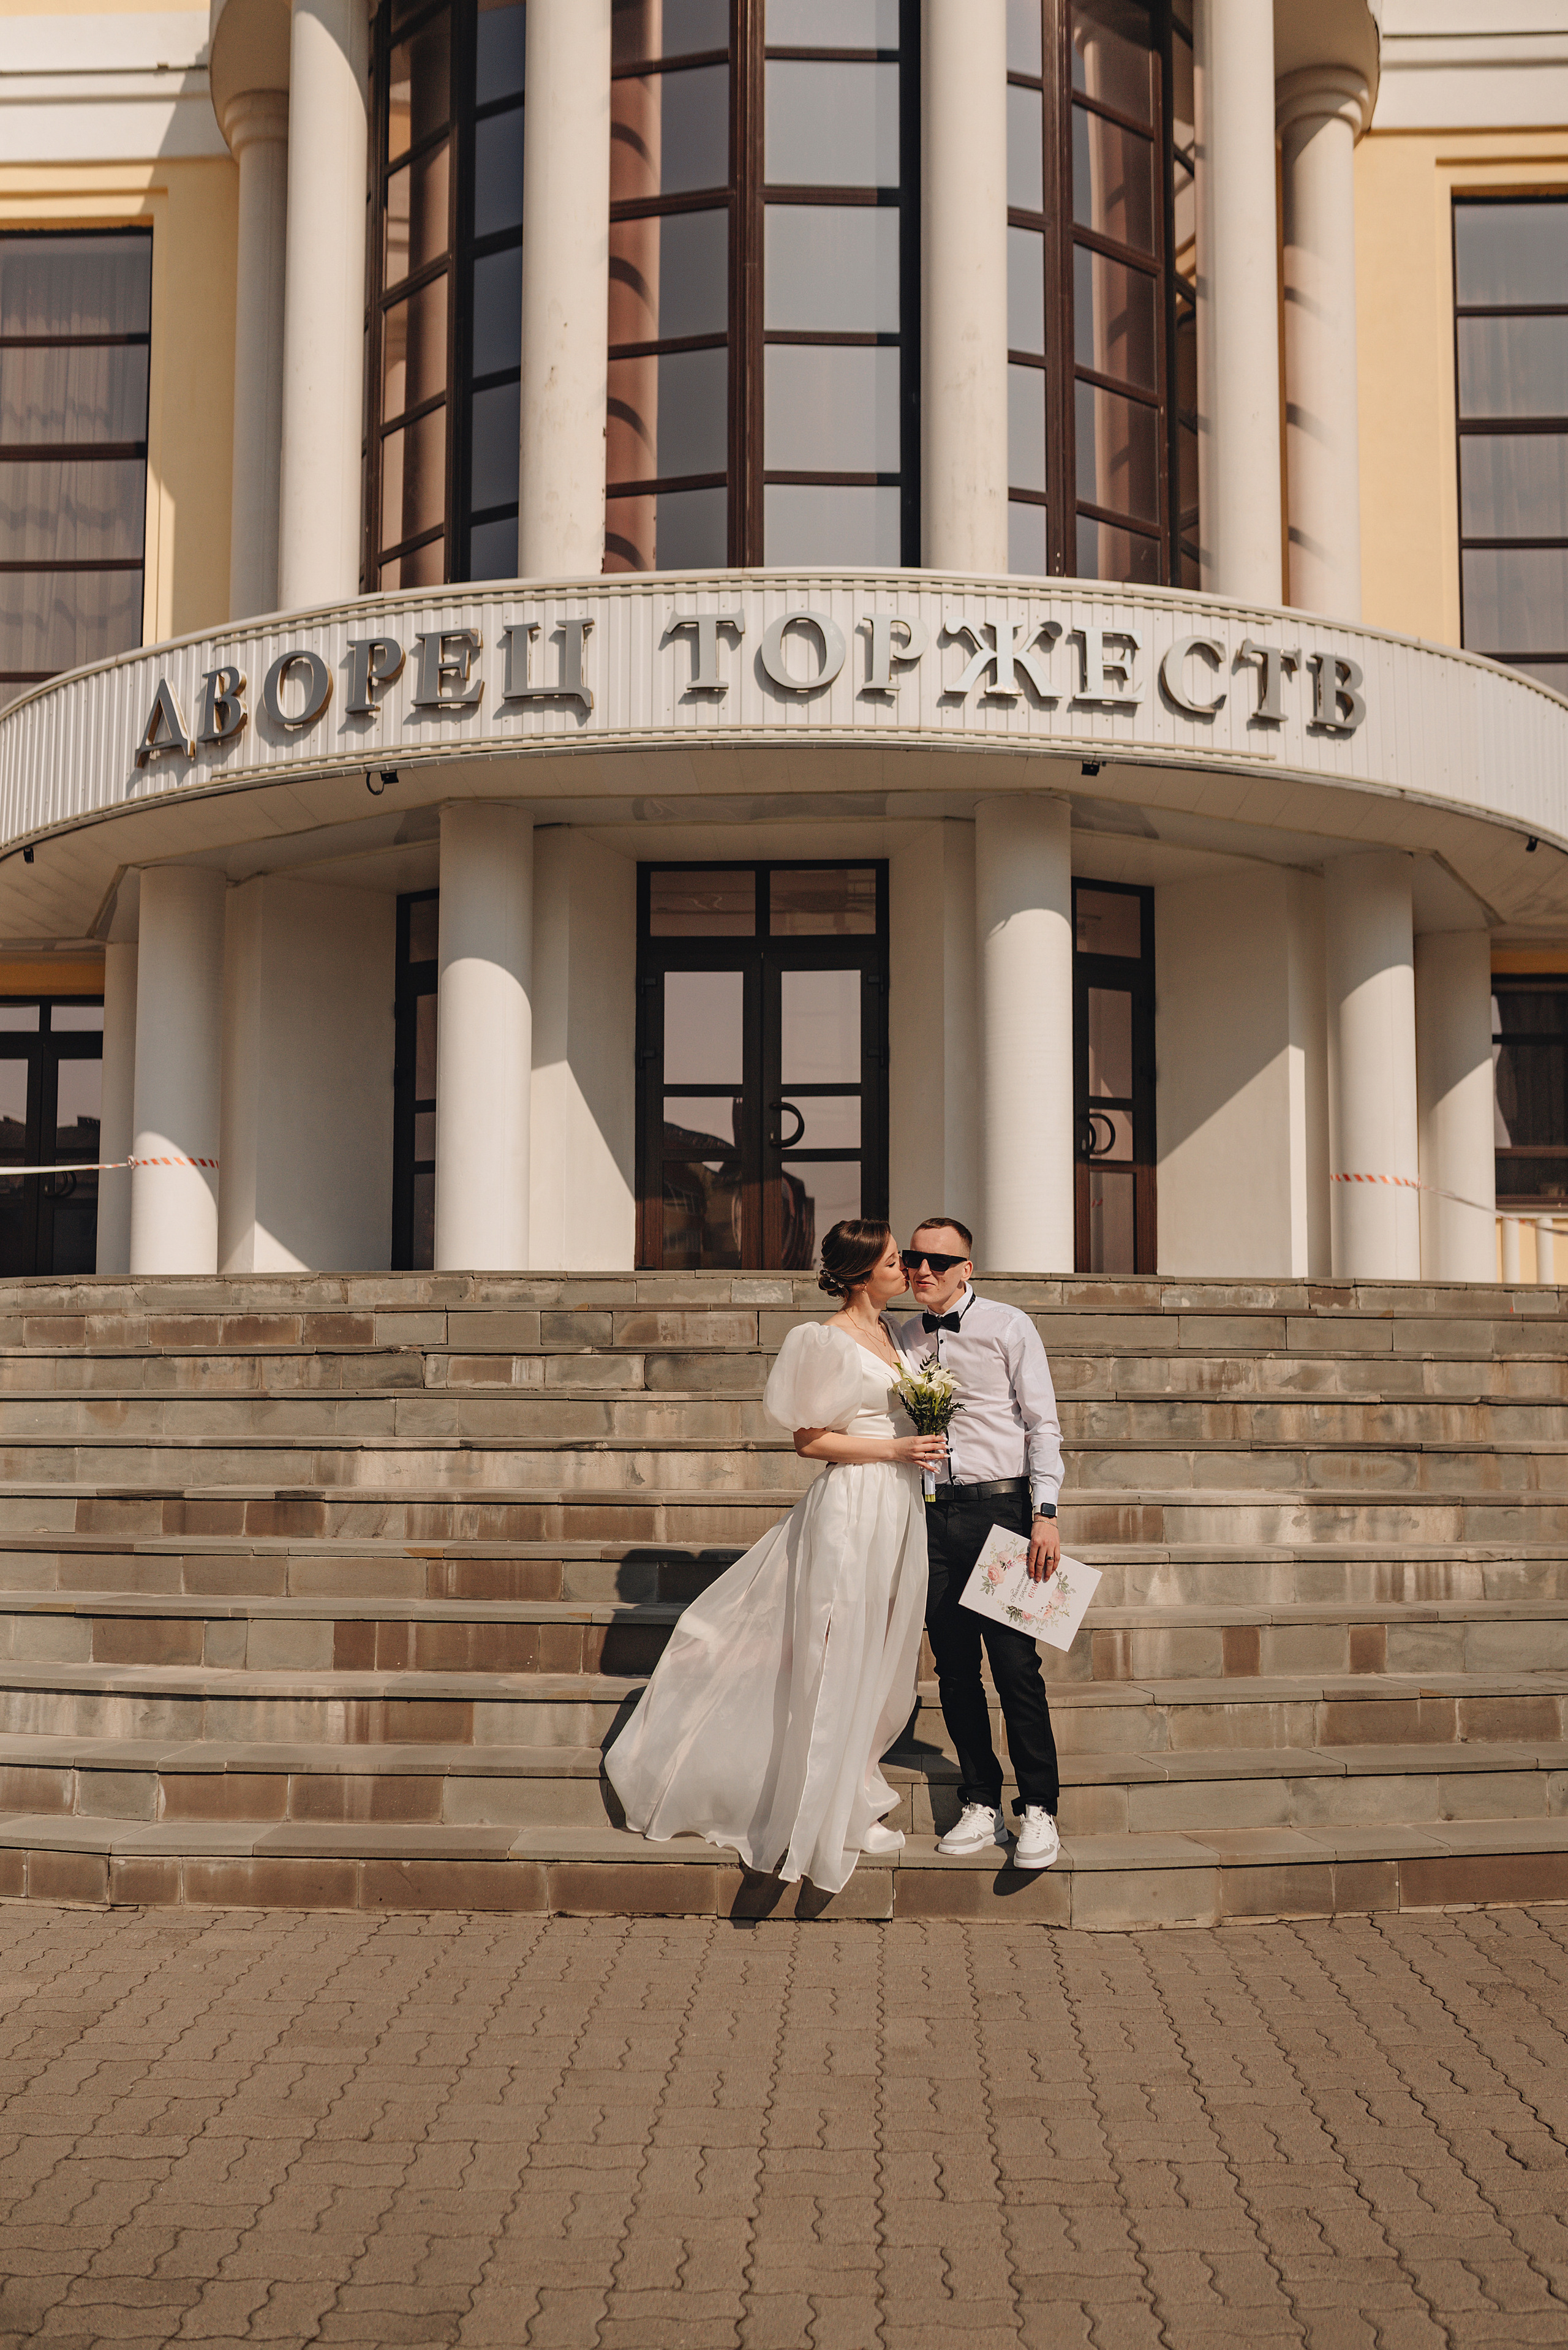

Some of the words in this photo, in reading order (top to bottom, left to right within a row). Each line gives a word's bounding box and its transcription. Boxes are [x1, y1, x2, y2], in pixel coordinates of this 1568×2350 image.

[135, 617, 595, 769] ДВОРЕЦ
[666, 608, 1366, 731] ТОРЖЕСТВ
[1028, 1583, 1039, 1598] БРАК
